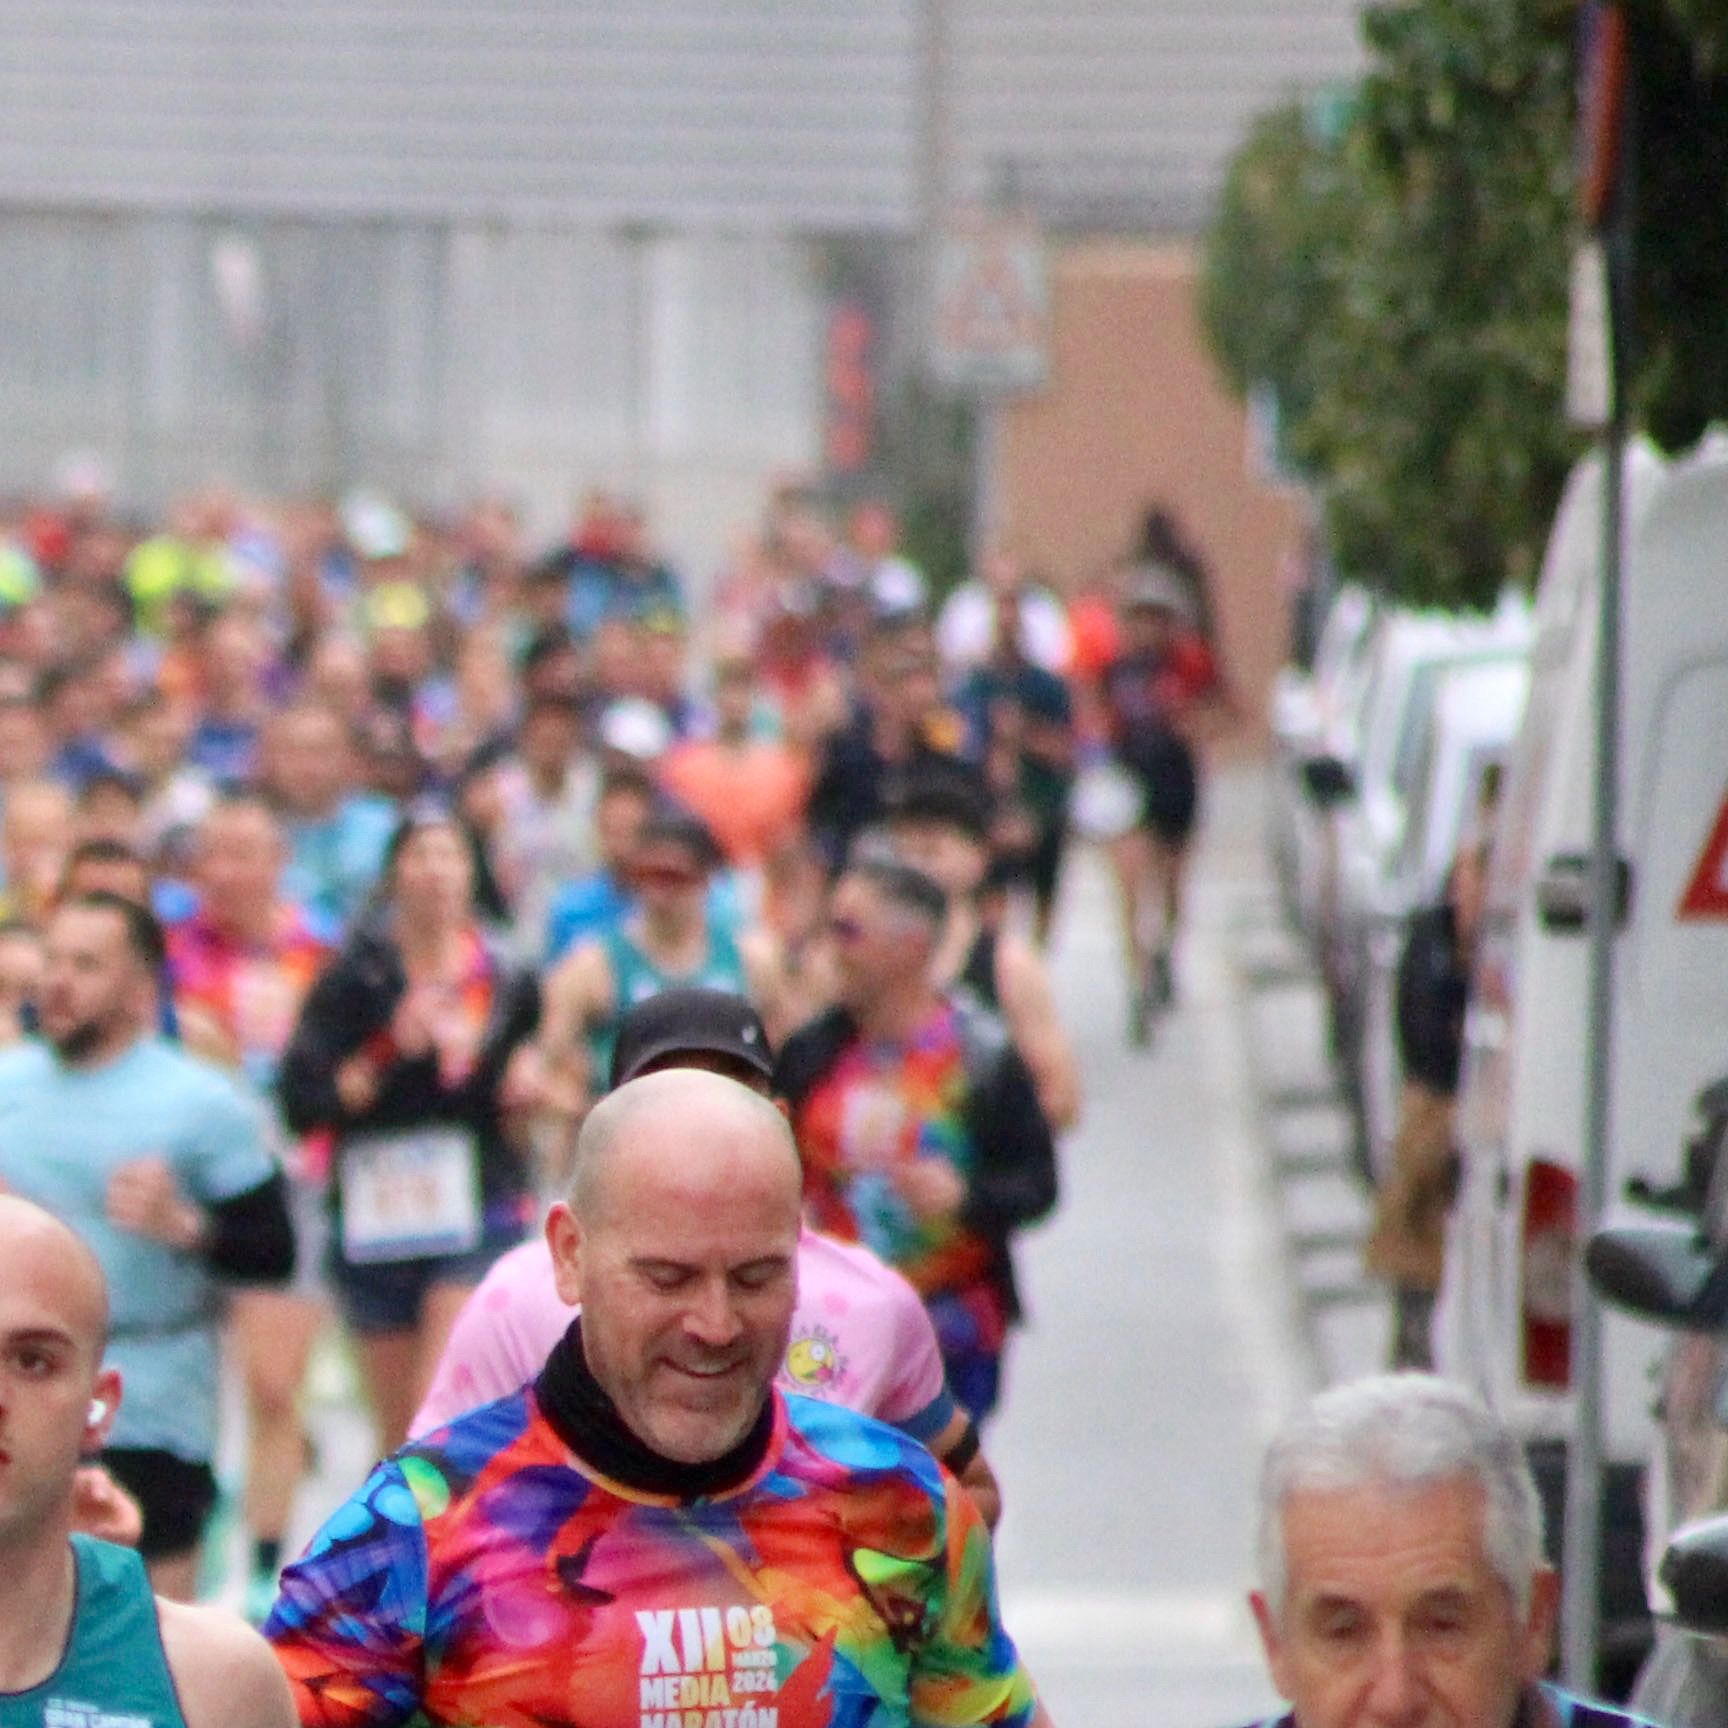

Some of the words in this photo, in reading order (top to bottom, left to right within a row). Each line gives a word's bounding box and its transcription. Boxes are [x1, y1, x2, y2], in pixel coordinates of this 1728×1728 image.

[634, 1606, 727, 1674] XII
[726, 1605, 777, 1648] 08
[640, 1673, 732, 1710] MEDIA
